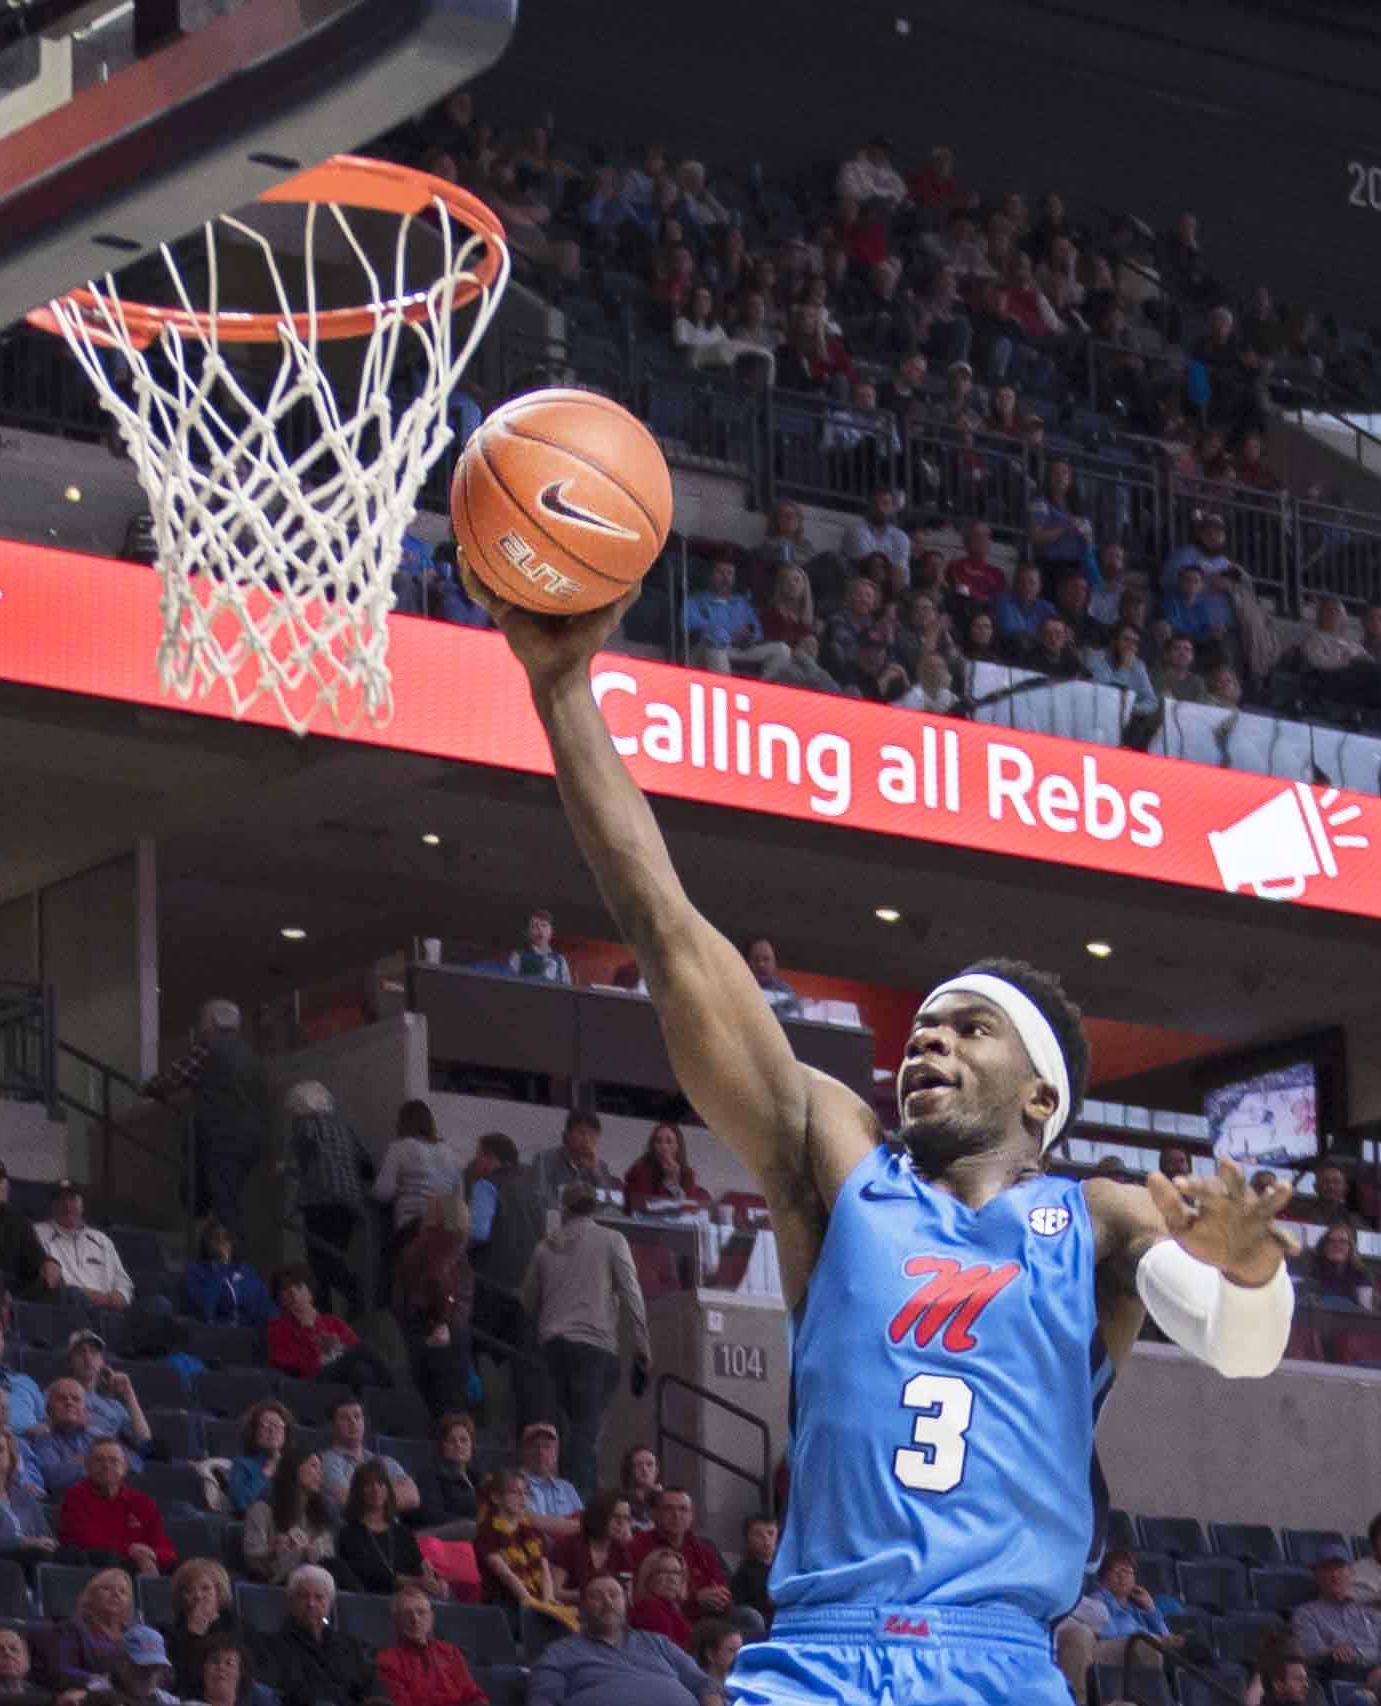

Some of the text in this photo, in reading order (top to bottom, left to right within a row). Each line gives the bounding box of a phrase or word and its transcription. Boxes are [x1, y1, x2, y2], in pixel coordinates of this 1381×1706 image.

[590, 671, 1164, 848] Calling all Rebs
[1029, 1206, 1071, 1237] SEC
[721, 1344, 764, 1379] 104
[893, 1371, 975, 1495] 3
